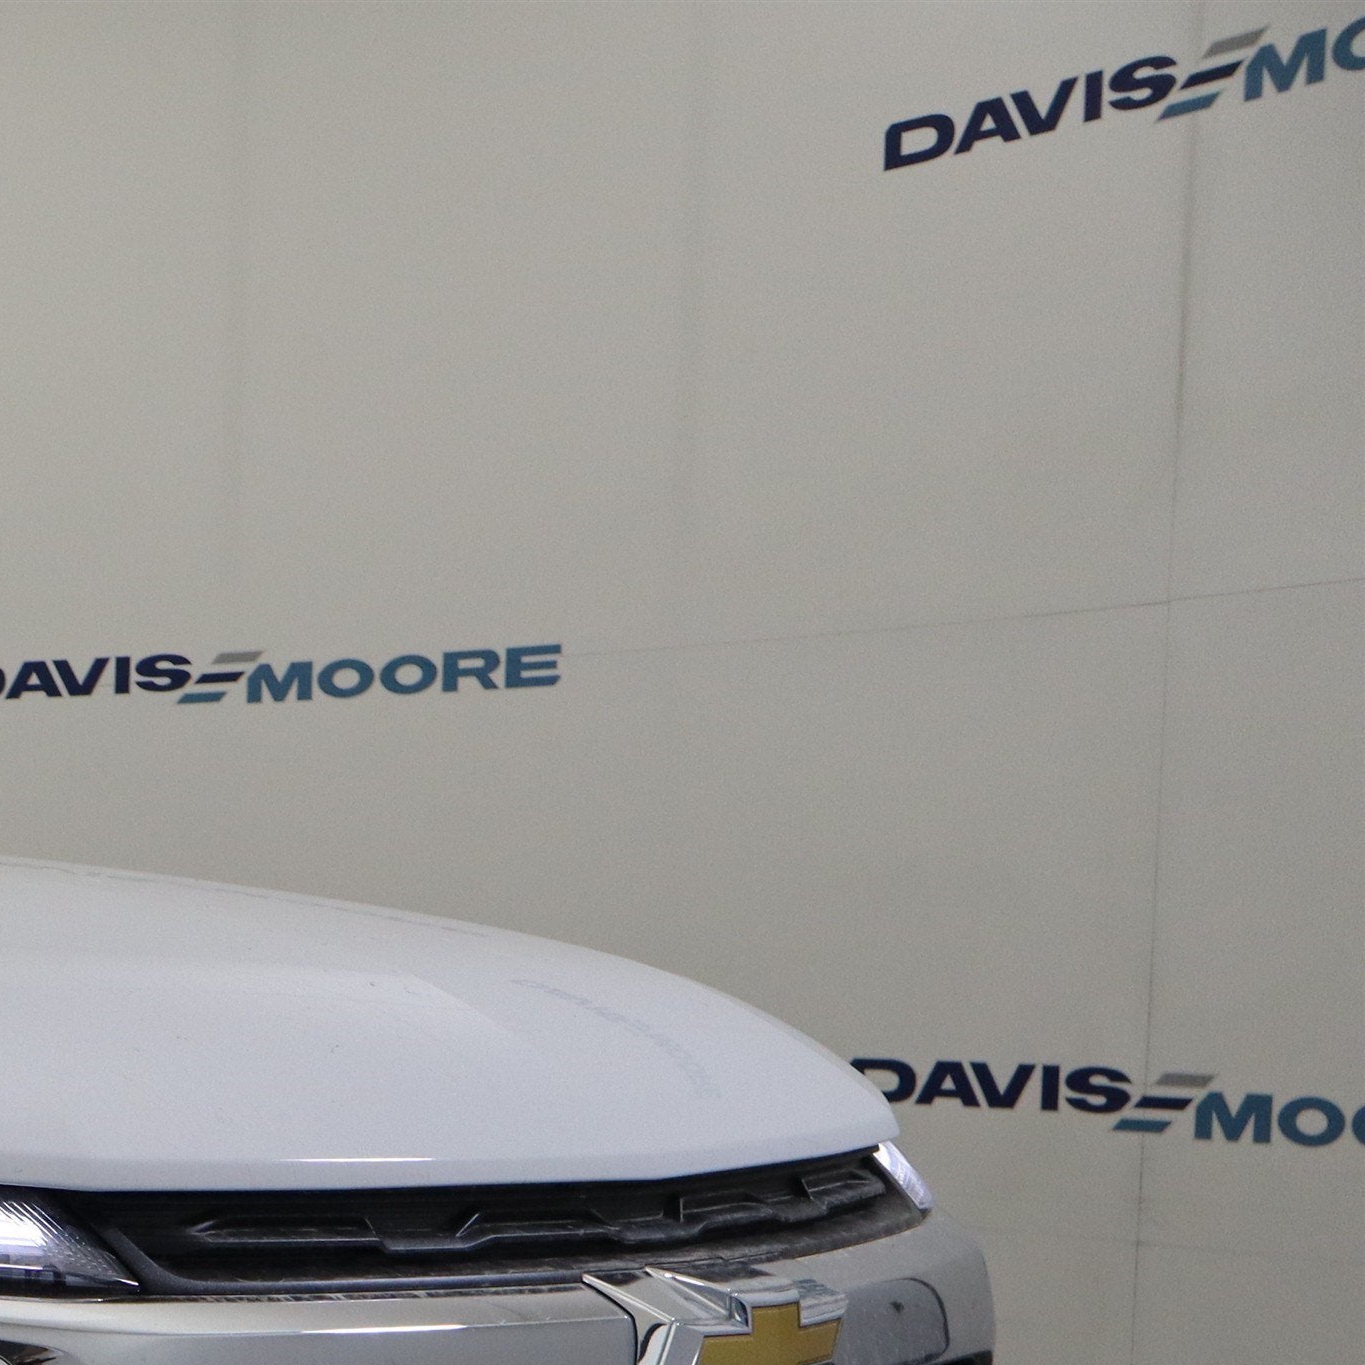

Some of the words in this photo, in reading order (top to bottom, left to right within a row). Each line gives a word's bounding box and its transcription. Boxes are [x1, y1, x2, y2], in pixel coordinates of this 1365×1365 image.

[883, 55, 1178, 172] DAVIS
[246, 644, 562, 704] MOORE
[849, 1057, 1132, 1115] DAVIS
[1194, 1091, 1365, 1148] MO
